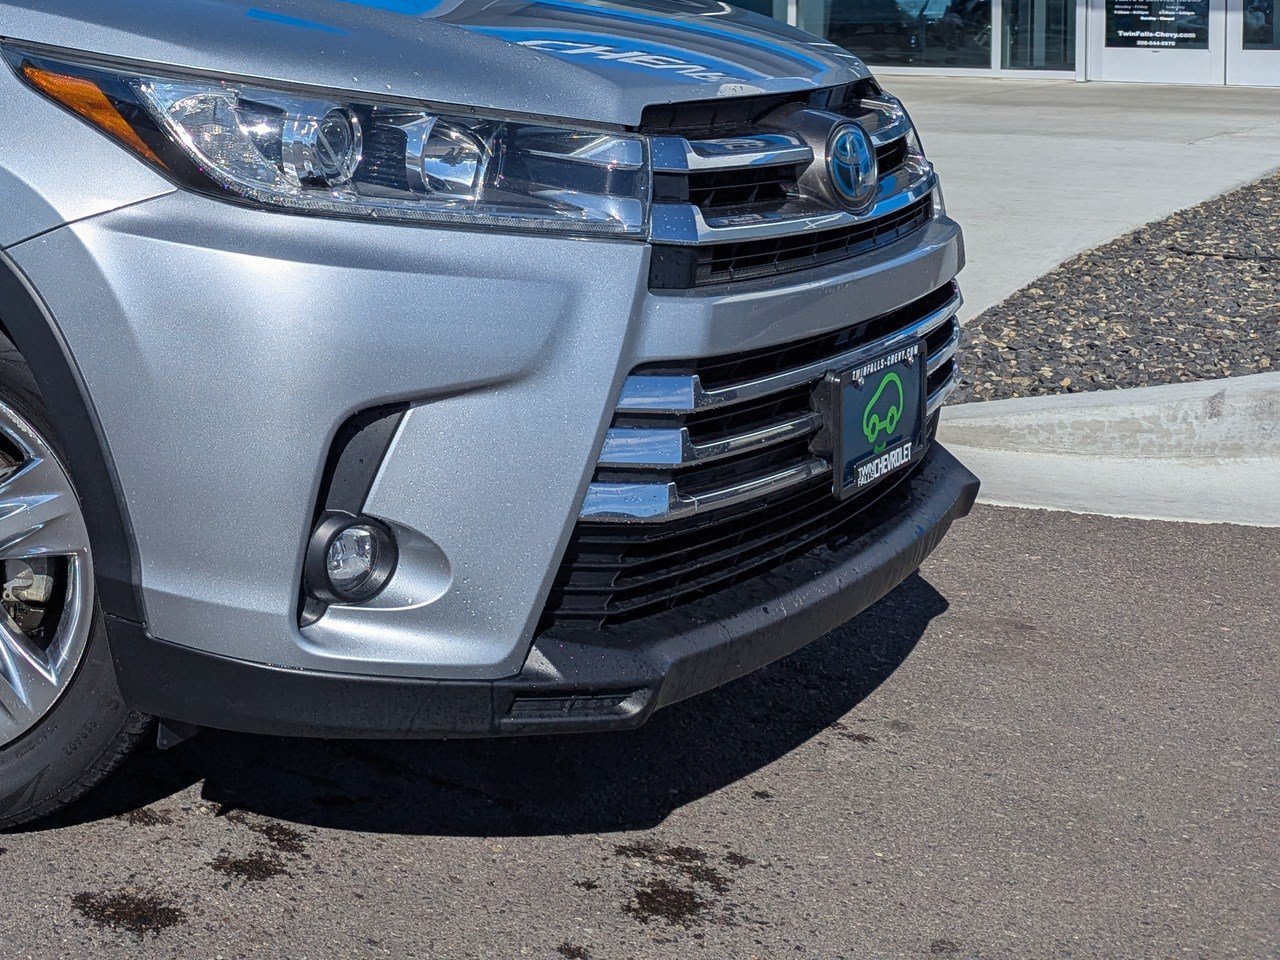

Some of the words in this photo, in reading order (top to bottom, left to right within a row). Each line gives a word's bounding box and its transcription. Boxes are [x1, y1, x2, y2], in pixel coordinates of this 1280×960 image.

[1117, 30, 1196, 39] TwinFalls-Chevy.com
[874, 442, 913, 479] CHEVROLET
[857, 471, 875, 488] FALLS
